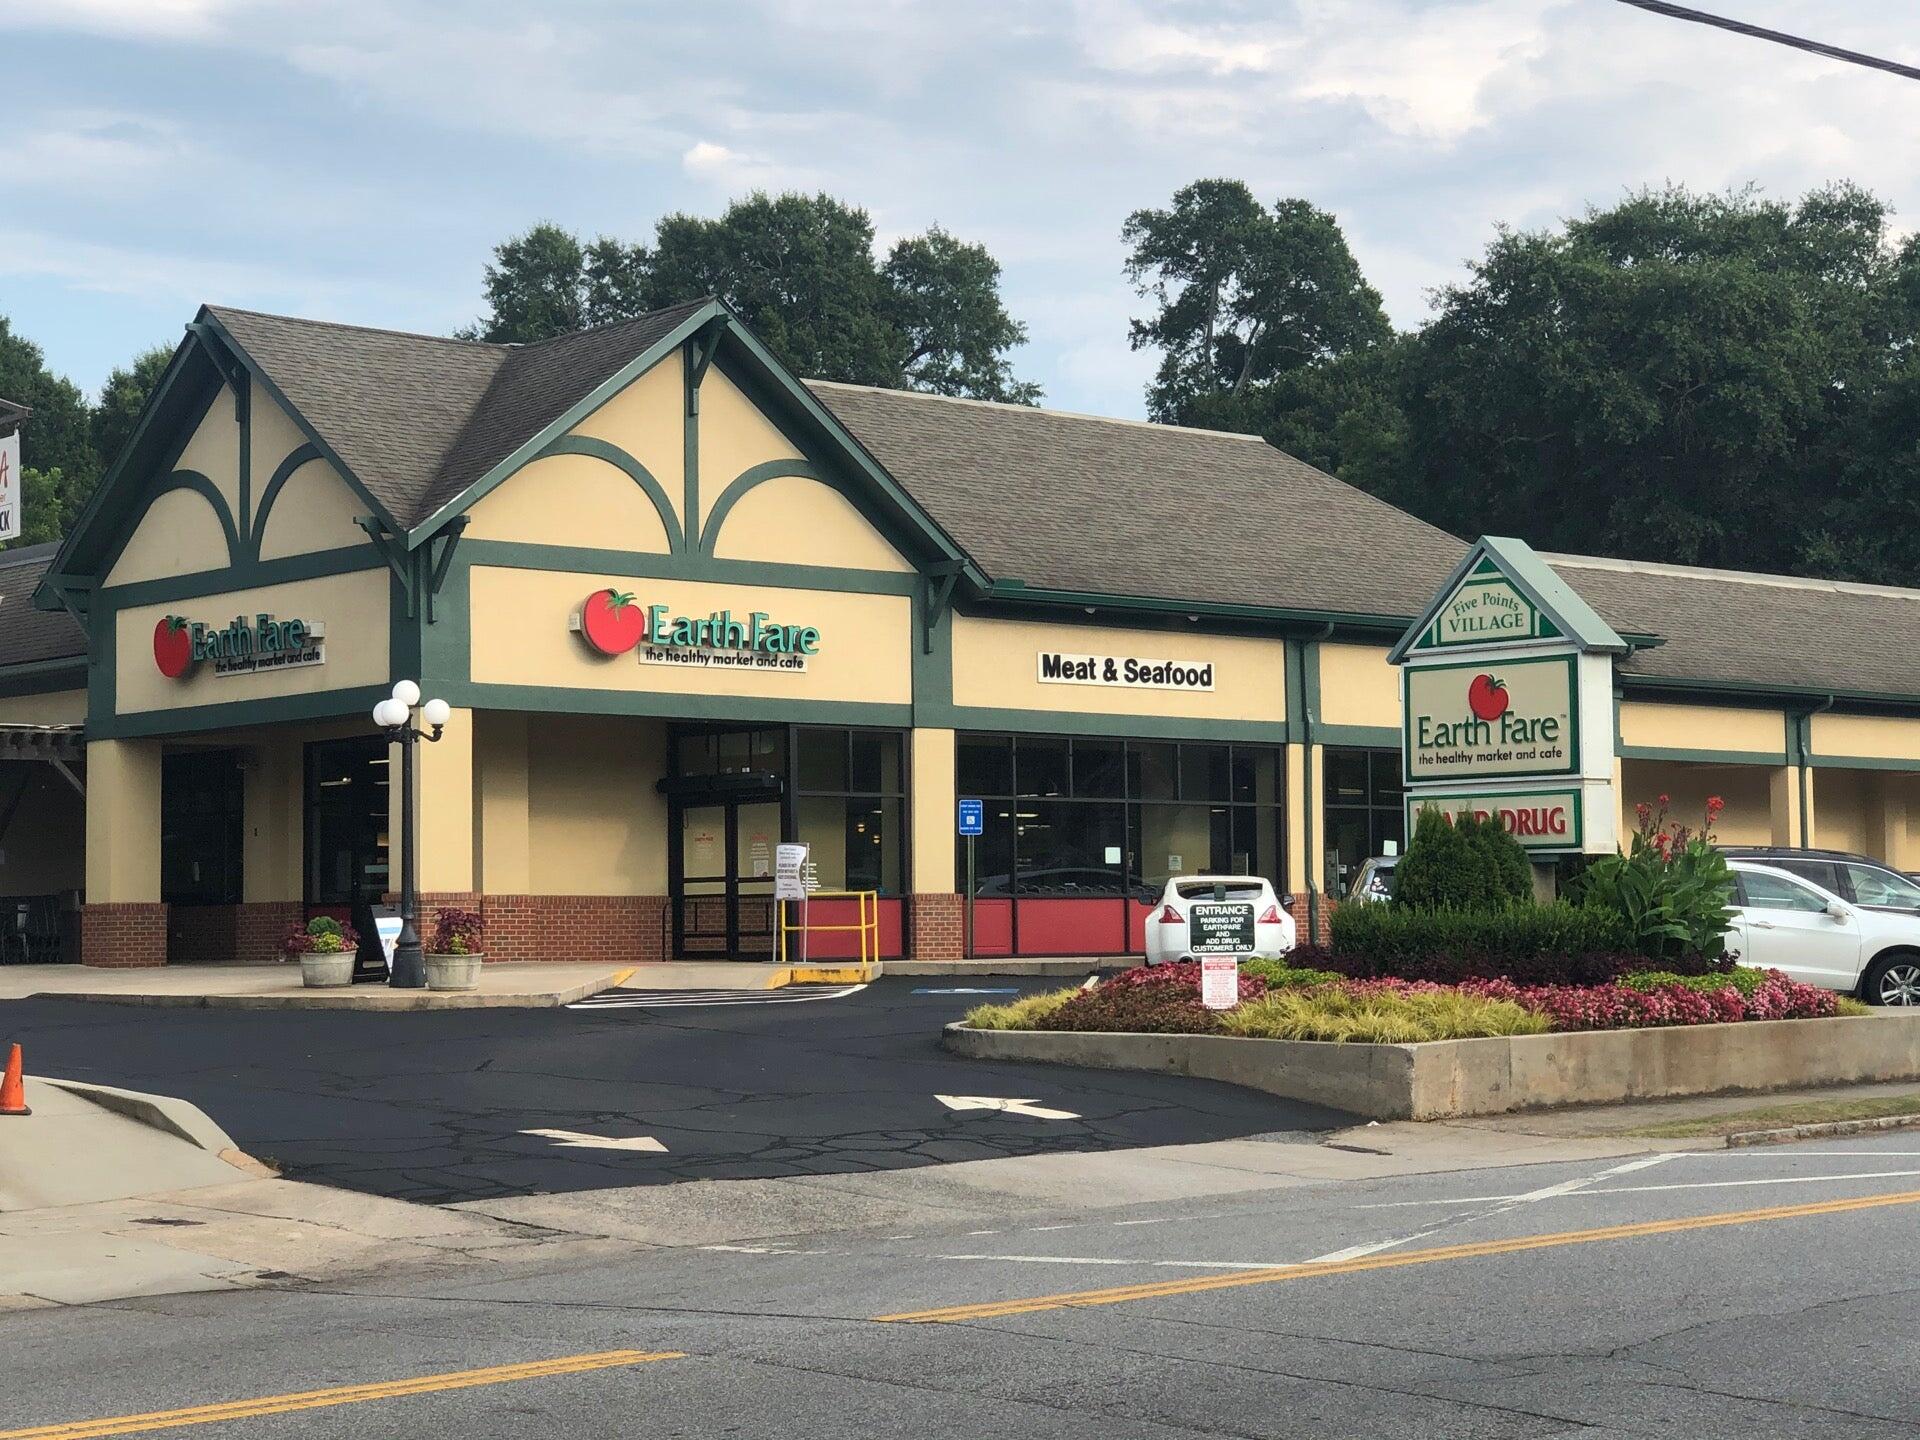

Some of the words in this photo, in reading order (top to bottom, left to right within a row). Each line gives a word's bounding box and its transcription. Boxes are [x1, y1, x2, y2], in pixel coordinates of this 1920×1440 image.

[1453, 598, 1478, 617] Five
[1482, 592, 1520, 612] Points
[648, 604, 744, 650] Earth
[749, 611, 821, 655] Fare
[1449, 613, 1525, 633] VILLAGE
[191, 615, 253, 661] Earth
[256, 613, 305, 652] Fare
[215, 659, 228, 673] the
[228, 655, 257, 672] healthy
[258, 652, 286, 668] market
[287, 650, 302, 664] and
[303, 647, 321, 661] cafe
[646, 648, 664, 661] the
[666, 648, 710, 666] healthy
[713, 652, 753, 666] market
[756, 655, 778, 668] and
[780, 655, 804, 669] cafe
[1042, 654, 1097, 680] Meat
[1103, 657, 1118, 682] &
[1124, 658, 1213, 687] Seafood
[1418, 713, 1492, 748] Earth
[1500, 710, 1560, 744] Fare
[1419, 753, 1434, 765] the
[1436, 750, 1473, 765] healthy
[1476, 748, 1512, 762] market
[1516, 748, 1536, 760] and
[1539, 746, 1563, 759] cafe
[1500, 806, 1567, 837] DRUG
[1195, 905, 1249, 916] ENTRANCE
[1200, 917, 1230, 925] PARKING
[1203, 923, 1242, 931] EARTHFARE
[1235, 944, 1254, 952] ONLY
